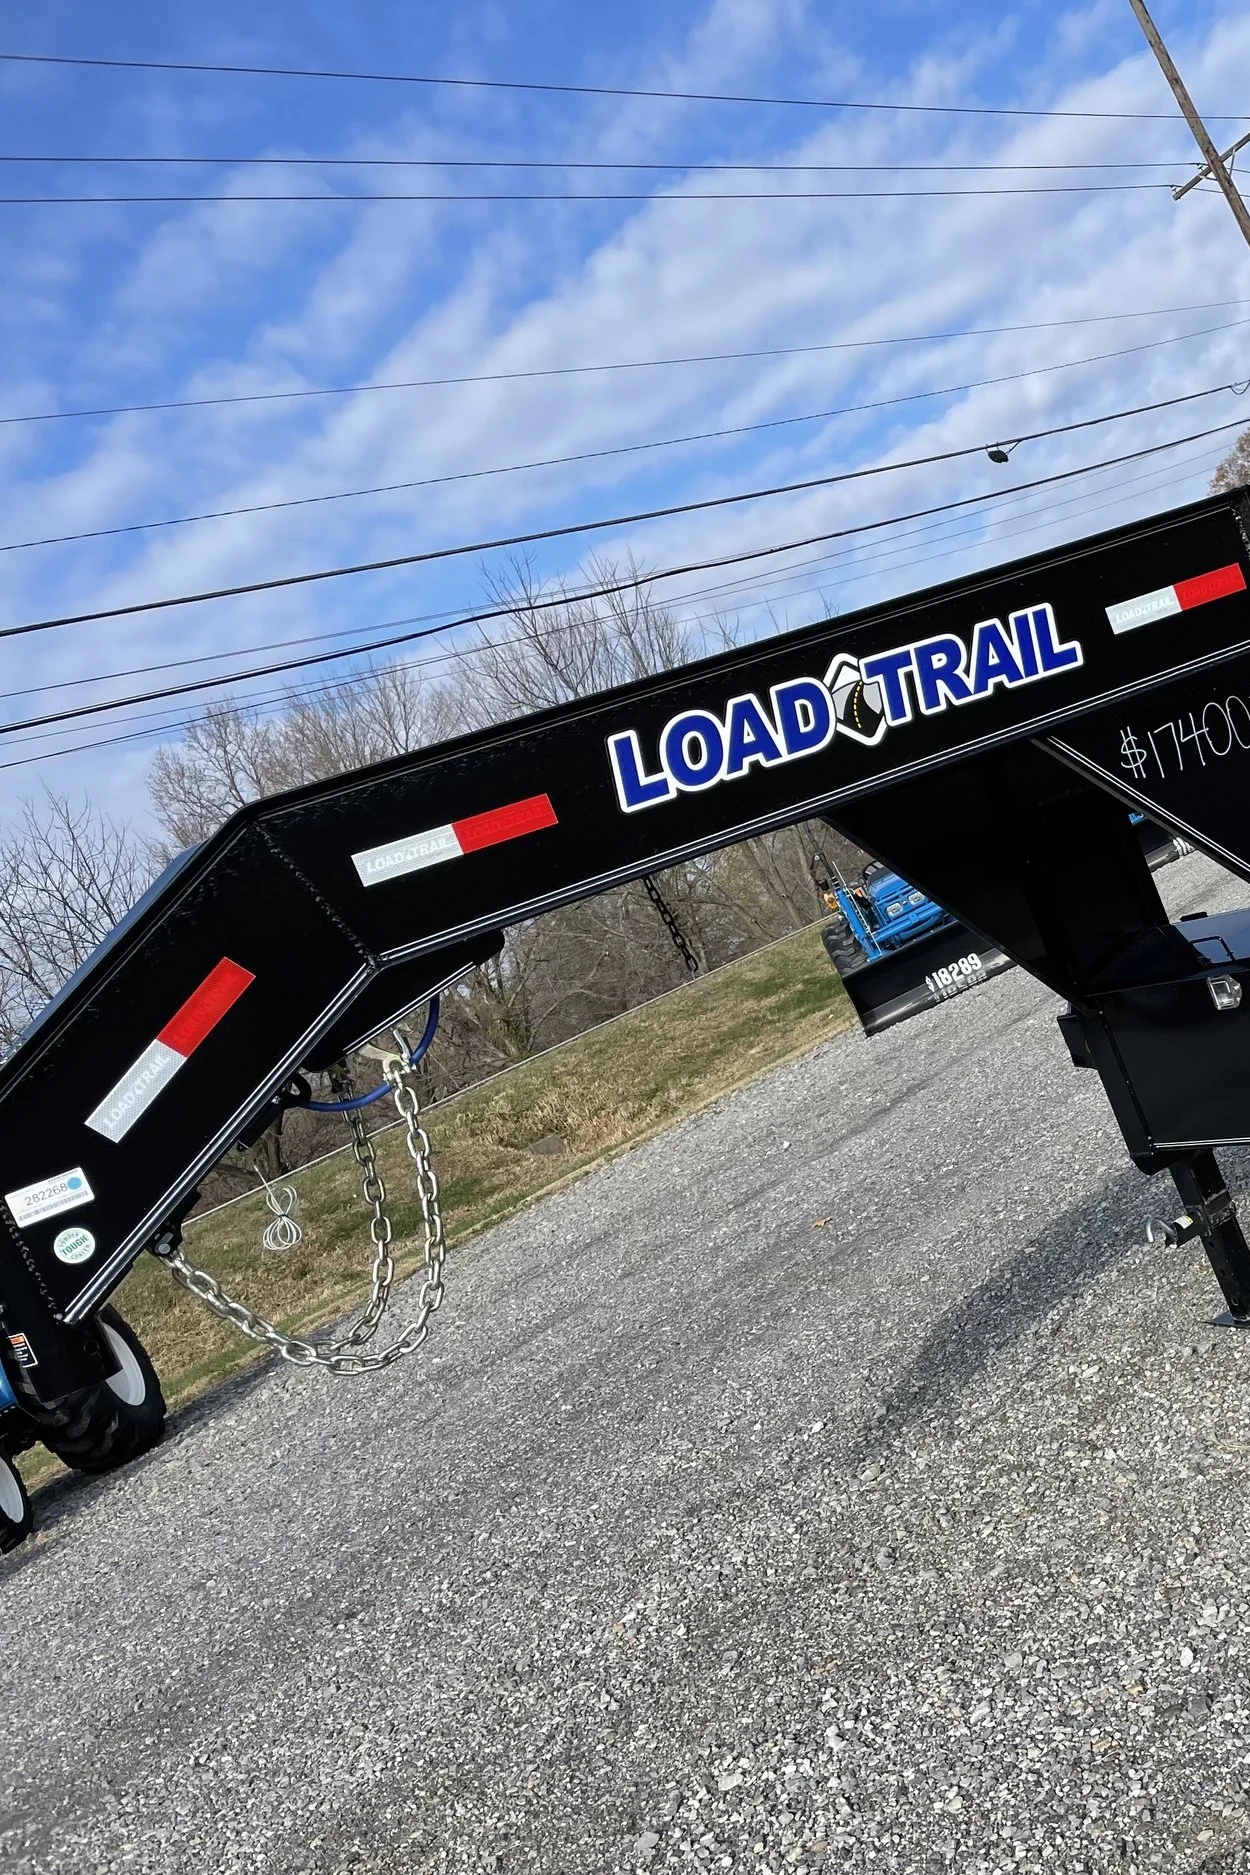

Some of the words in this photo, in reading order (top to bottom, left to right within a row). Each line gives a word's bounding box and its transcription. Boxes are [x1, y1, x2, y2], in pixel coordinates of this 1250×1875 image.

[606, 676, 836, 813] LOAD
[859, 602, 1084, 727] TRAIL
[366, 853, 405, 874] LOAD
[411, 836, 453, 860] TRAIL
[924, 953, 983, 993] $18289
[103, 1092, 137, 1129] LOAD
[134, 1053, 171, 1092] TRAIL
[25, 1183, 68, 1206] 282268
[60, 1236, 89, 1256] TOUGH
